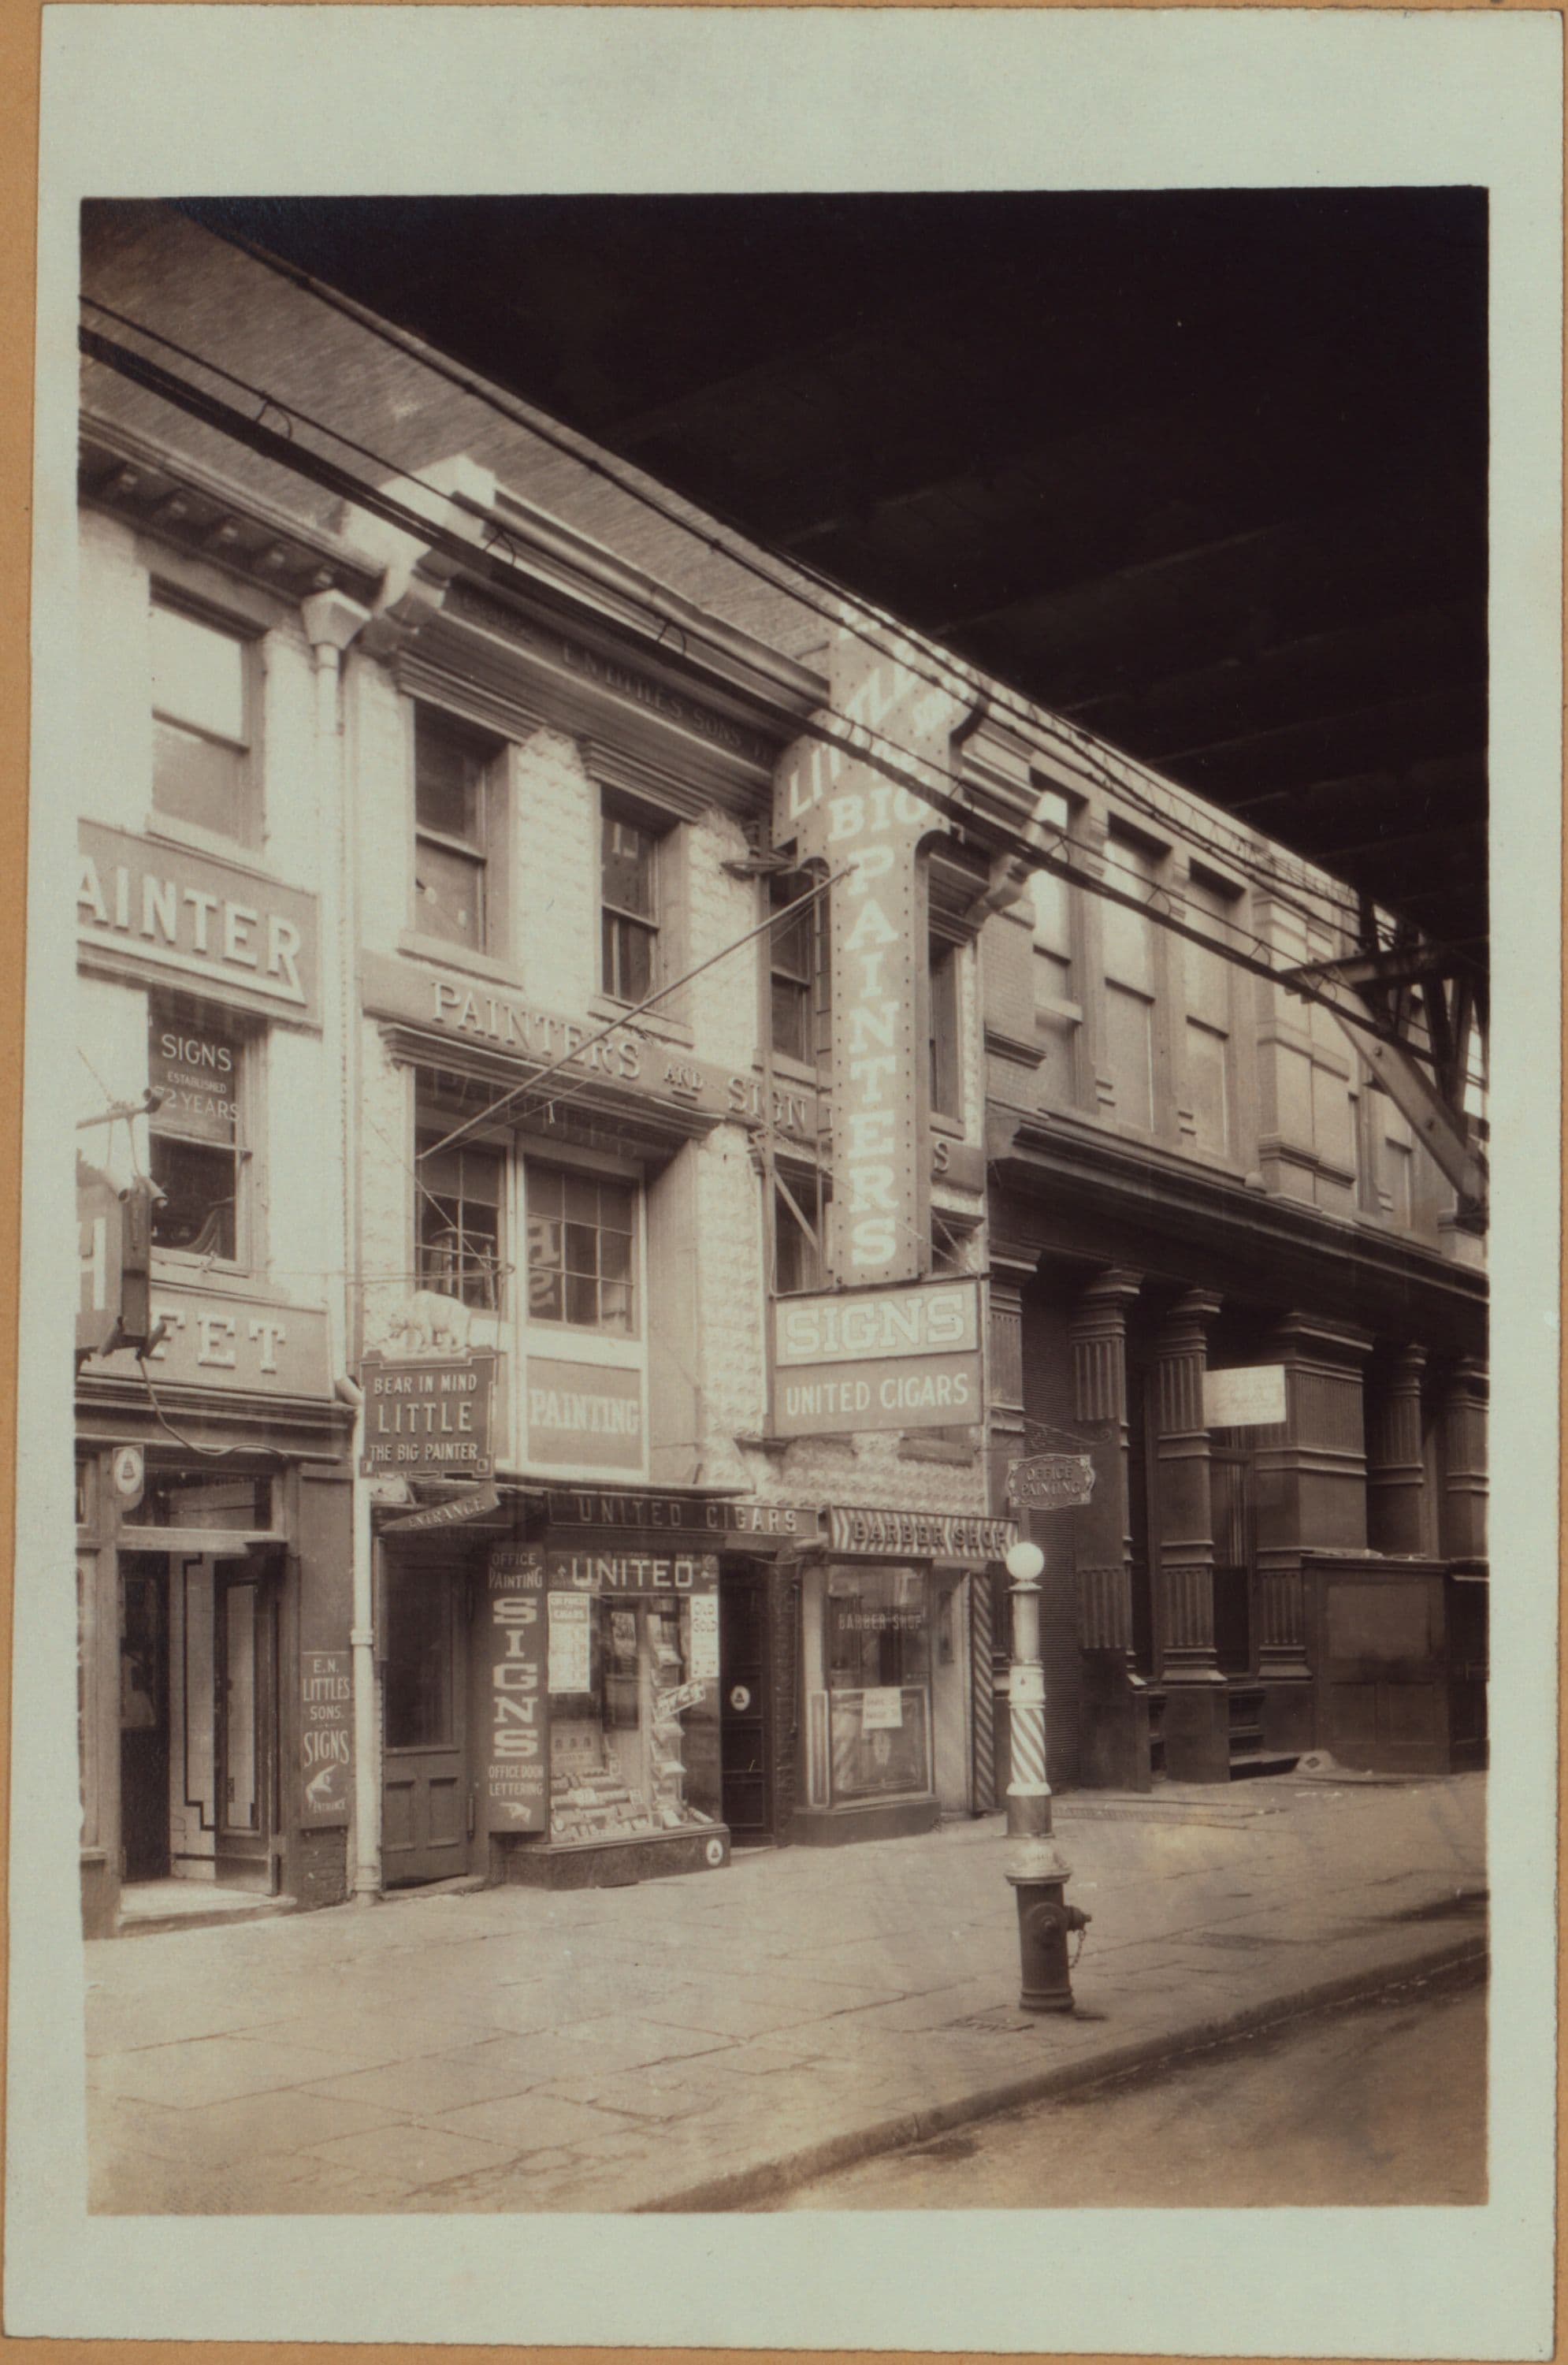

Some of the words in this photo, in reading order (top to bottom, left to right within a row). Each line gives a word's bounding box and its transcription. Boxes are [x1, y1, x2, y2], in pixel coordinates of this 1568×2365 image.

[161, 1033, 232, 1072] SIGNS
[432, 982, 642, 1080] PAINTERS
[663, 1062, 704, 1091] AND
[842, 844, 900, 1265] PAINTERS
[167, 1071, 227, 1095] ESTABLISHED
[180, 1091, 241, 1122] YEARS
[786, 1292, 965, 1355] SIGNS
[374, 1378, 412, 1396] BEAR
[419, 1375, 434, 1393] IN
[440, 1374, 477, 1393] MIND
[786, 1381, 871, 1417] UNITED
[879, 1373, 968, 1411] CIGARS
[377, 1401, 473, 1434] LITTLE
[528, 1388, 641, 1436] PAINTING
[370, 1445, 392, 1463] THE
[397, 1444, 419, 1462] BIG
[425, 1442, 479, 1461] PAINTER
[408, 1497, 486, 1527] ENTRANCE
[576, 1497, 682, 1527] UNITED
[706, 1503, 797, 1533] CIGARS
[852, 1517, 946, 1546] BARBER
[953, 1525, 1006, 1551] SHOP
[491, 1552, 536, 1567] OFFICE
[572, 1556, 694, 1589] UNITED
[489, 1567, 543, 1590] PAINTING
[313, 1658, 340, 1674] E.N.
[492, 1597, 539, 1757] SIGNS
[303, 1730, 350, 1768] SIGNS
[488, 1764, 520, 1779] OFFICE
[521, 1764, 544, 1779] DOOR
[489, 1782, 544, 1798] LETTERING
